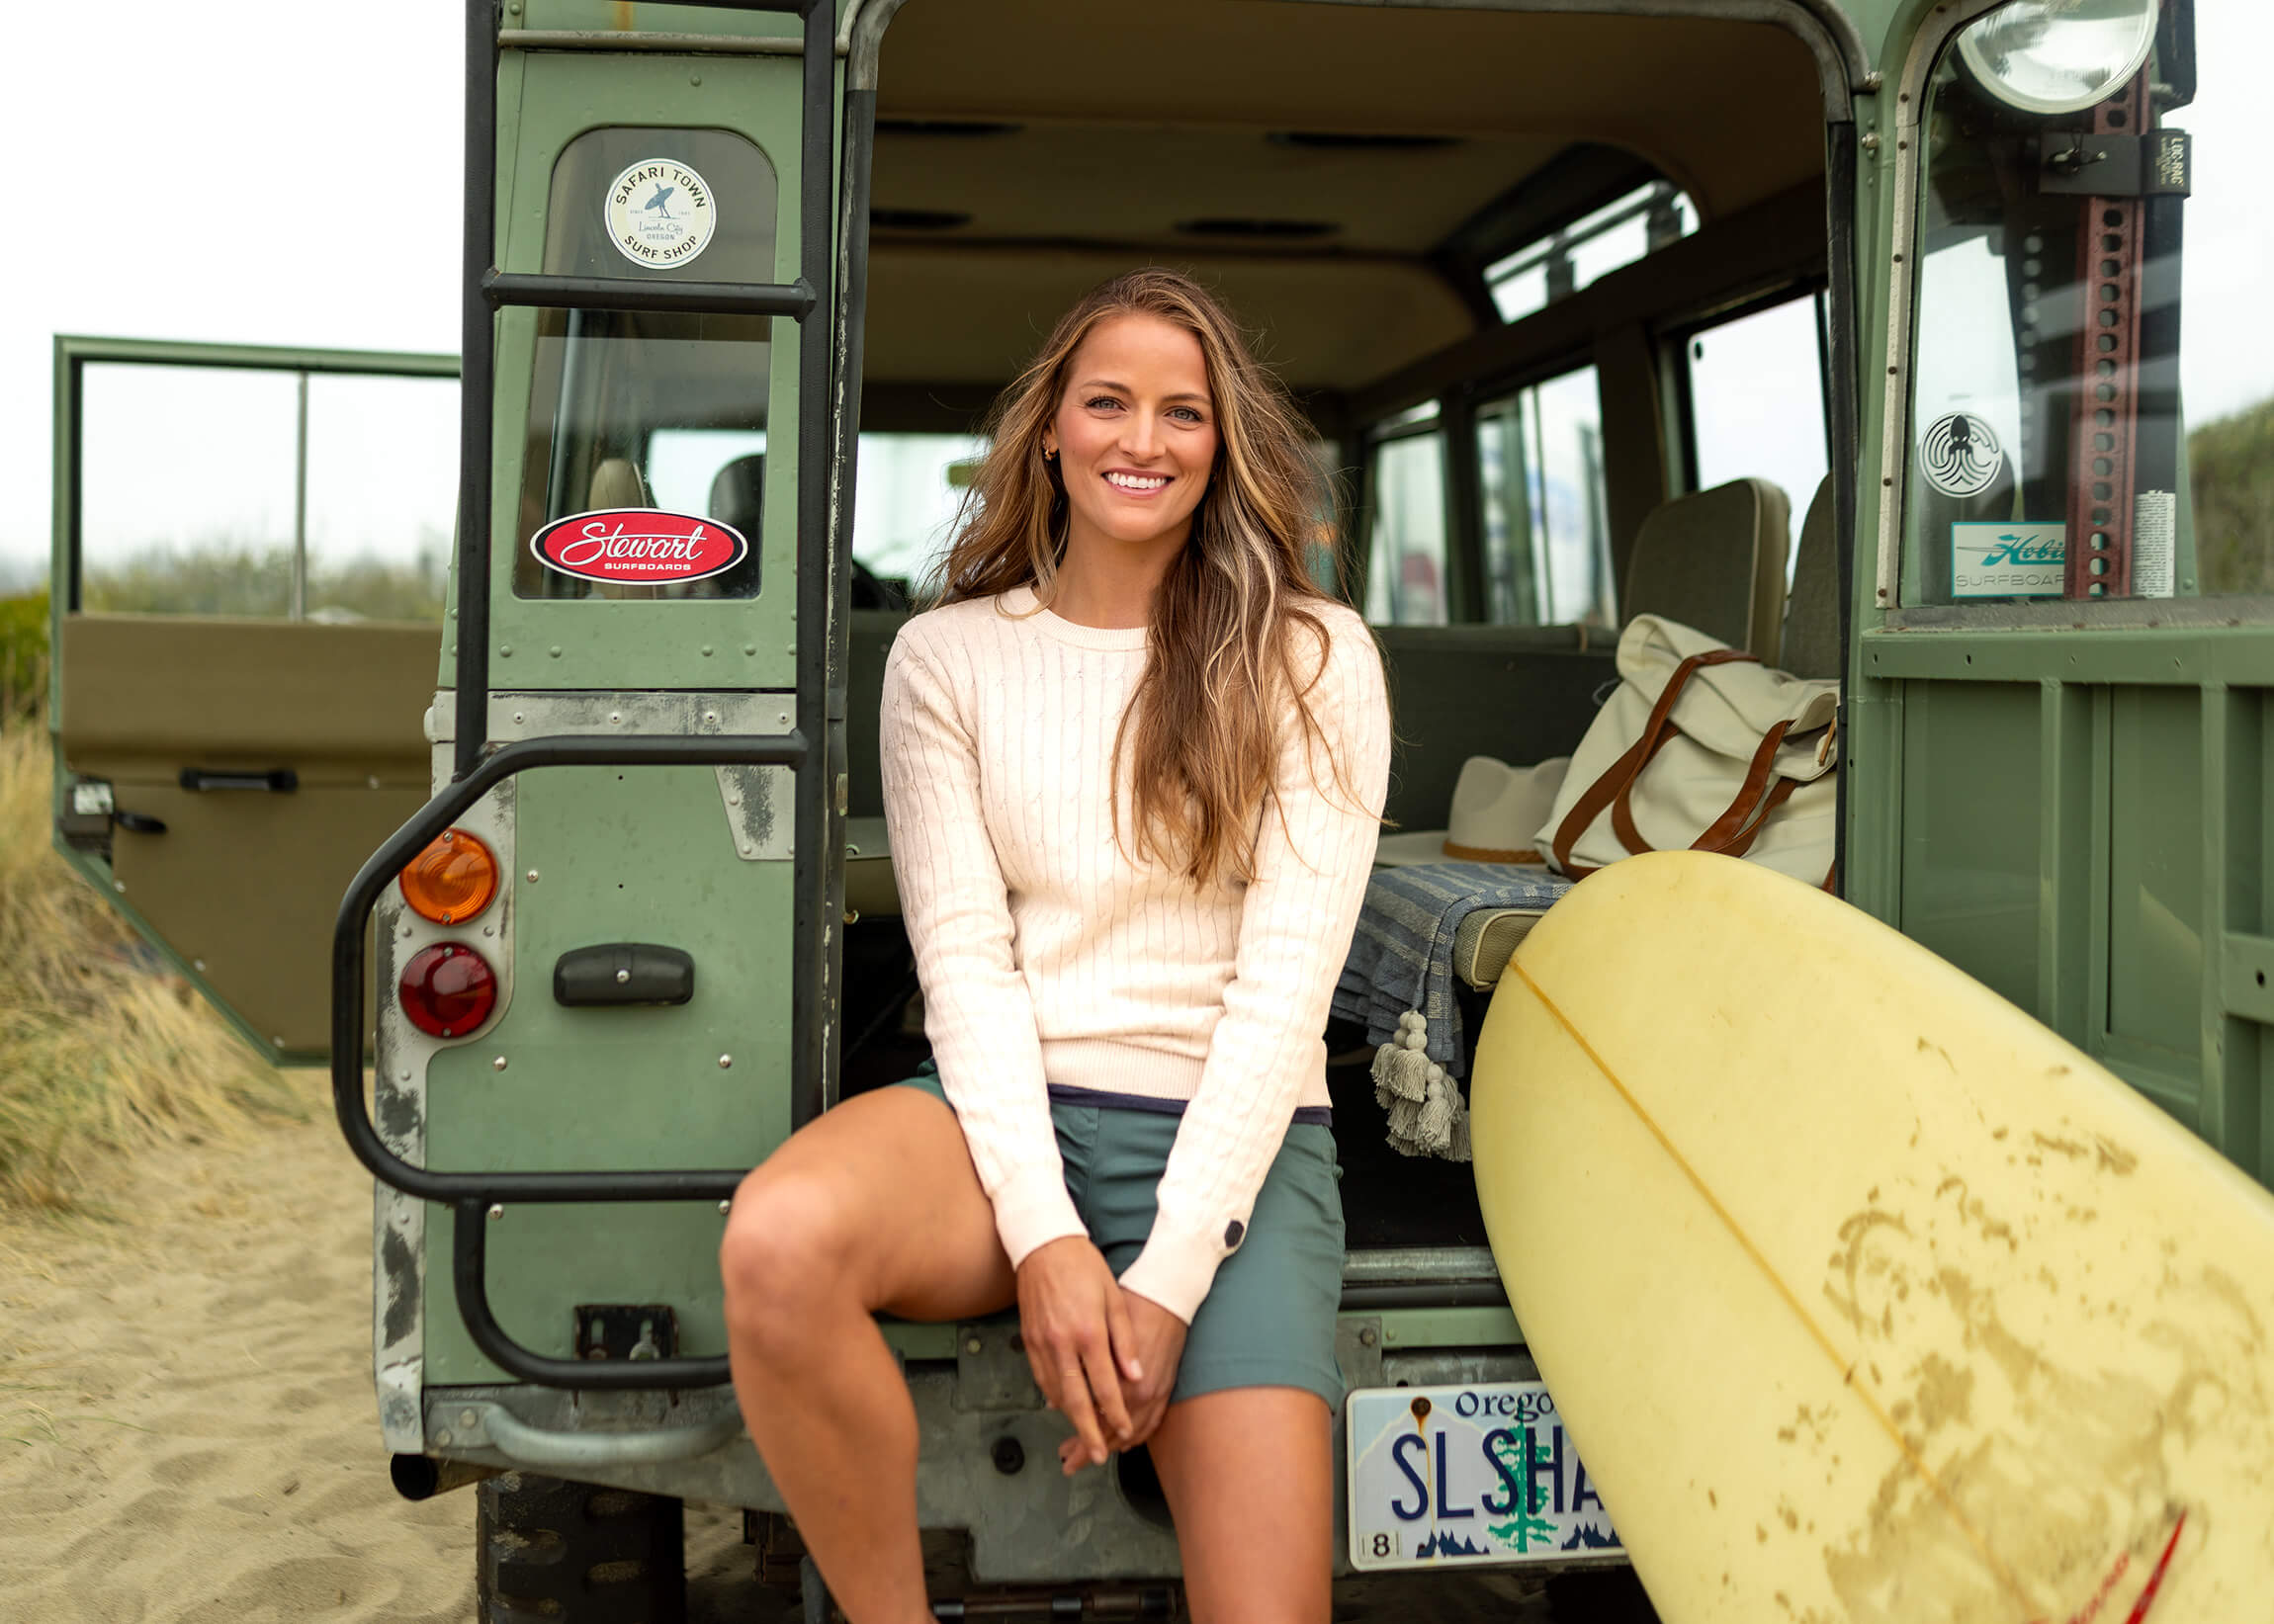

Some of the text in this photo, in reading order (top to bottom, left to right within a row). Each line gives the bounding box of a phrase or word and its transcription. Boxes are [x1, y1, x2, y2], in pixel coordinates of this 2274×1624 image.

[616, 166, 707, 209] SAFARI TOWN
[624, 235, 698, 260] SURF SHOP
[560, 522, 708, 566] Stewart
[604, 562, 692, 571] SURFBOARDS
[1454, 1391, 1556, 1423] Orego
[1391, 1425, 1606, 1521] SLSHA
[1373, 1533, 1390, 1557] 8
